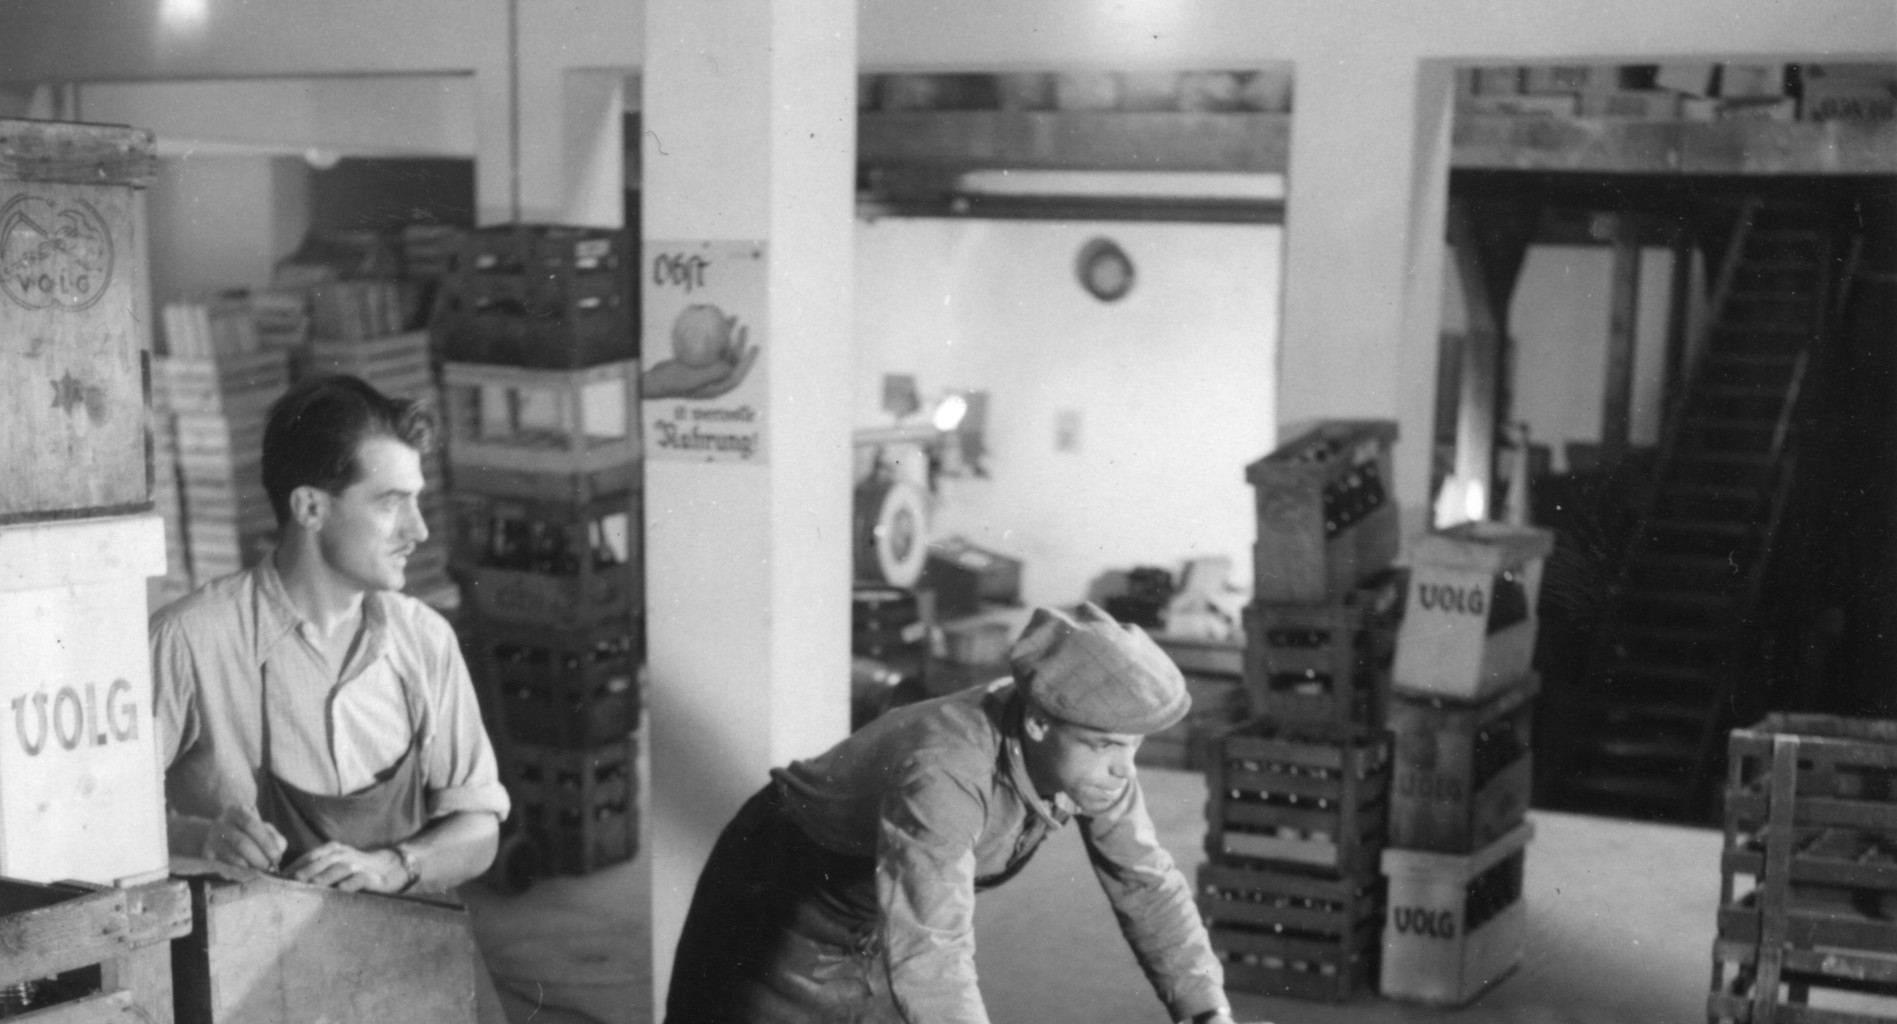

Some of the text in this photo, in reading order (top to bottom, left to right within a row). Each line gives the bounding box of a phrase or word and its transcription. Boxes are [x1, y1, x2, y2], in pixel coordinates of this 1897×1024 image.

[1419, 584, 1484, 616] VOLG
[11, 678, 139, 757] VOLG
[1394, 906, 1455, 939] VOLG
